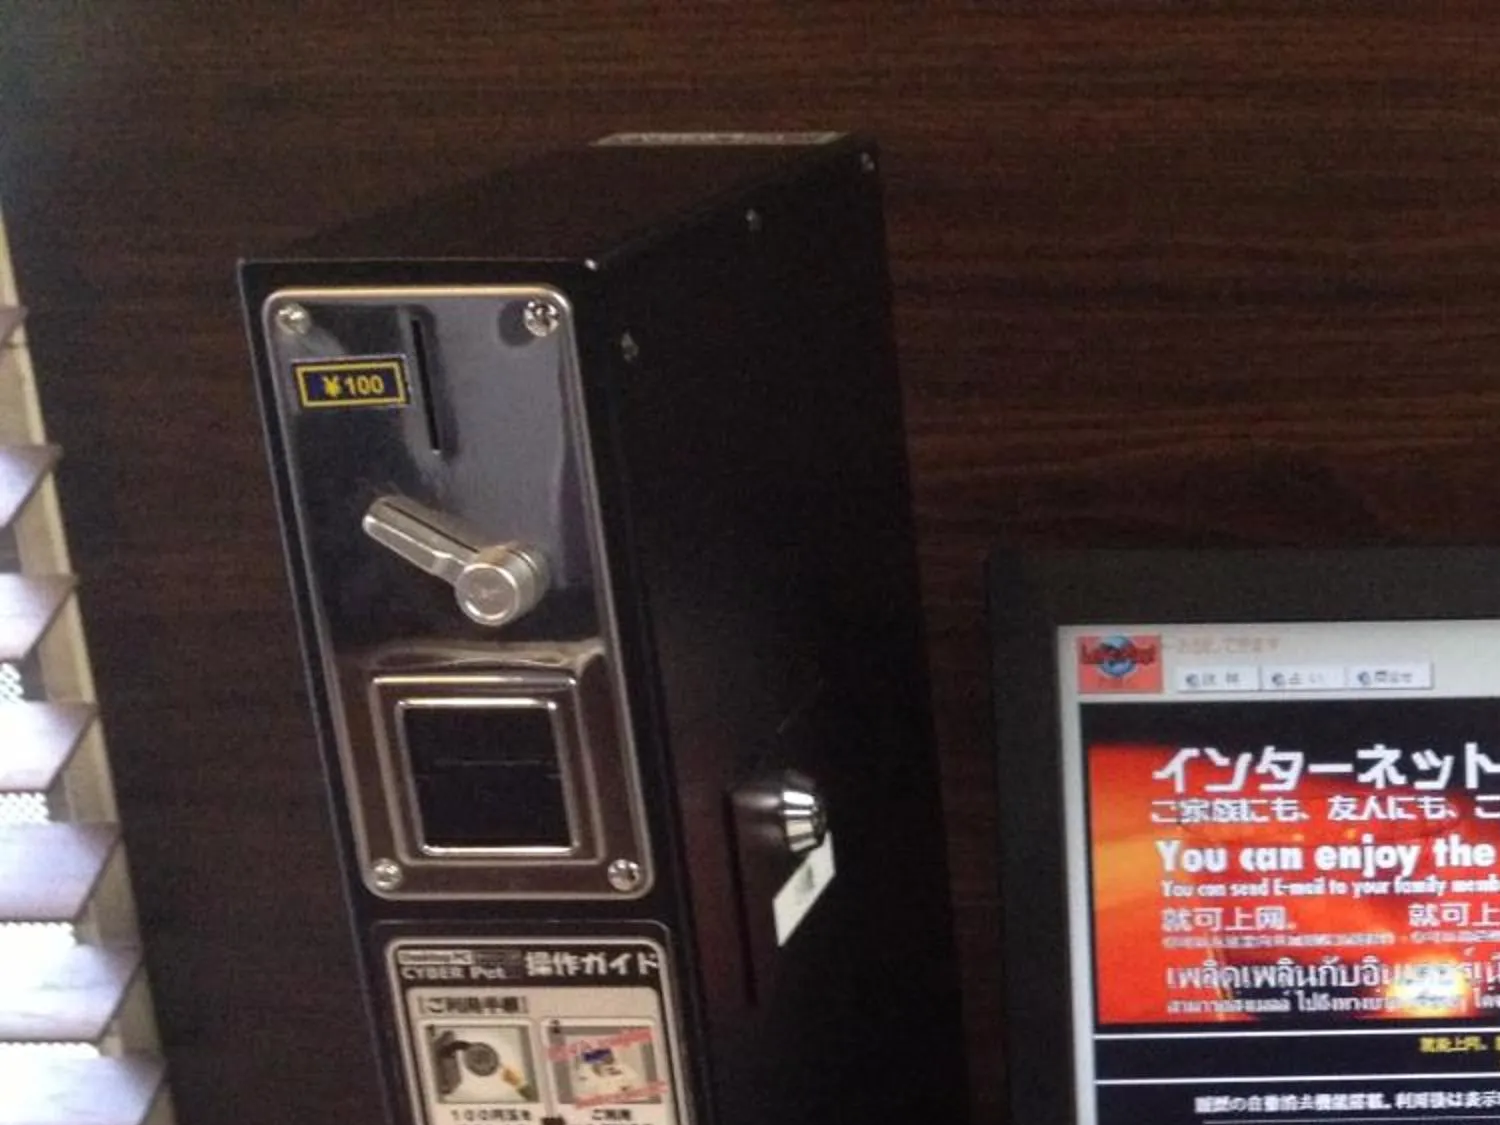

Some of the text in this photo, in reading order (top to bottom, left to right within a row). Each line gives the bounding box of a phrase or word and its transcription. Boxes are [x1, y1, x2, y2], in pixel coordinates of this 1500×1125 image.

[1155, 840, 1228, 874] You
[1240, 847, 1304, 873] can
[1315, 834, 1421, 878] enjoy
[1433, 834, 1495, 868] the
